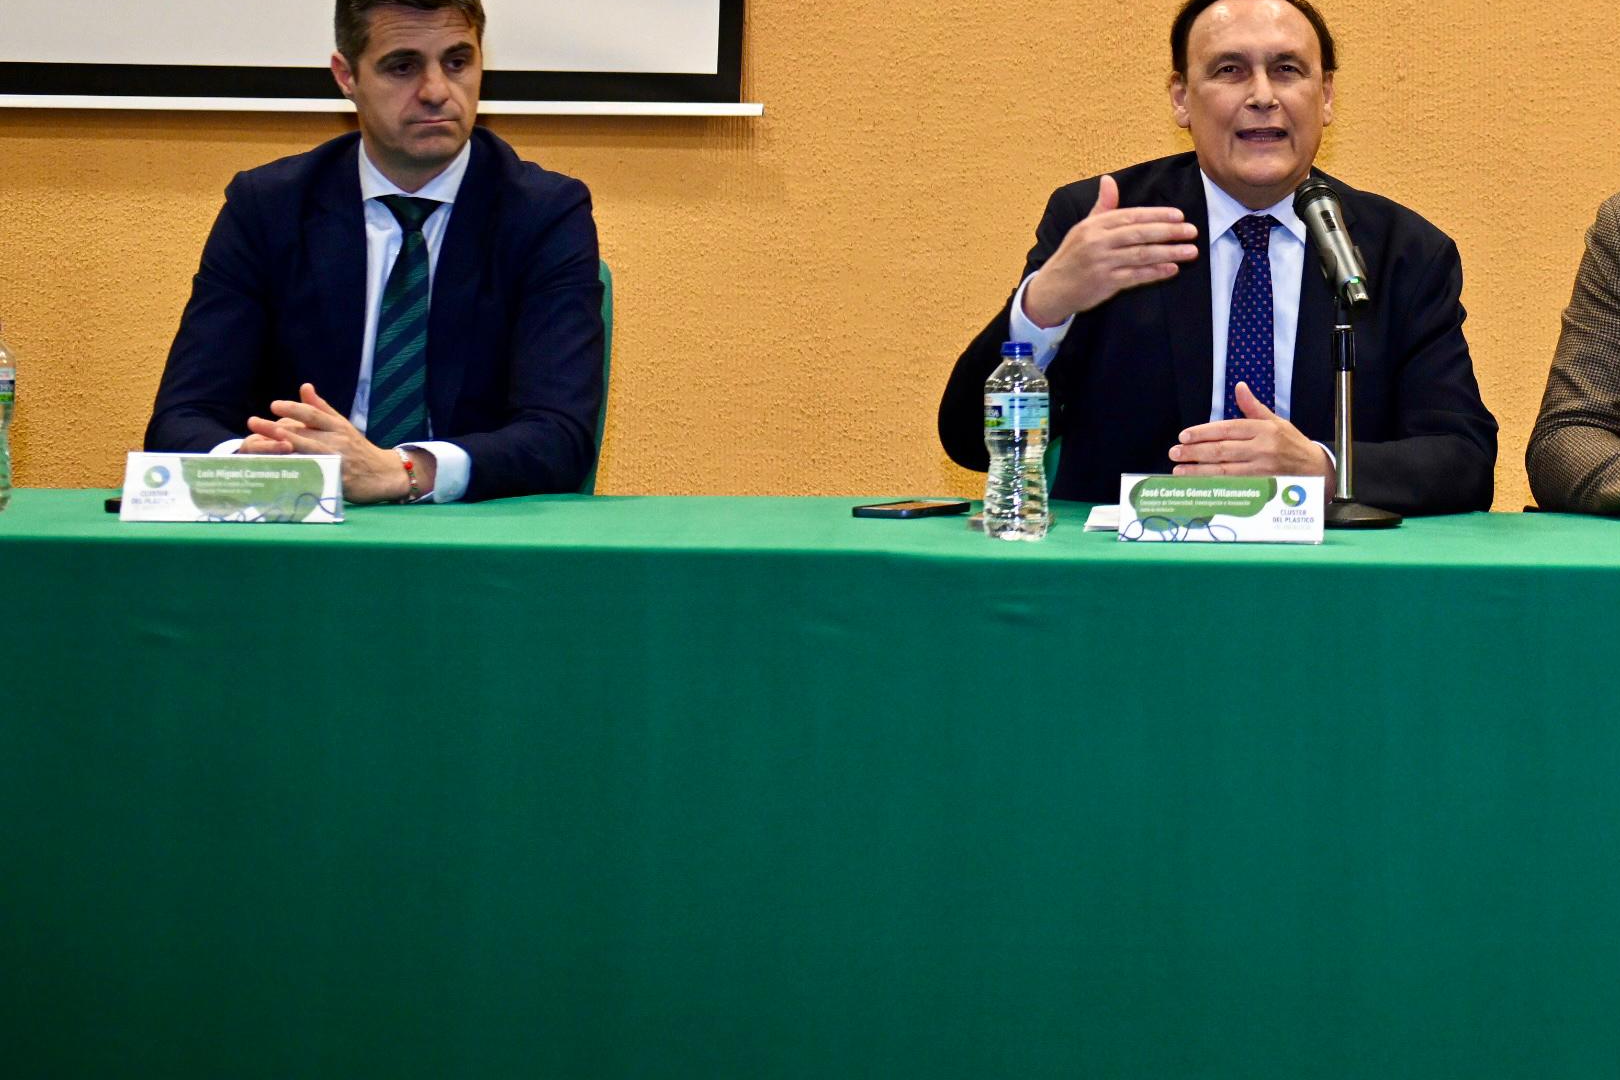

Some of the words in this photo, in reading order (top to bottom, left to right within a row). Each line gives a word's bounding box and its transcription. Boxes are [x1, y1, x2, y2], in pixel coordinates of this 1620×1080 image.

[216, 470, 243, 480] Miguel
[244, 470, 280, 479] Carmona
[1140, 488, 1159, 498] José
[1160, 488, 1185, 497] Carlos
[1186, 488, 1212, 498] Gómez
[1213, 489, 1260, 497] Villamandos
